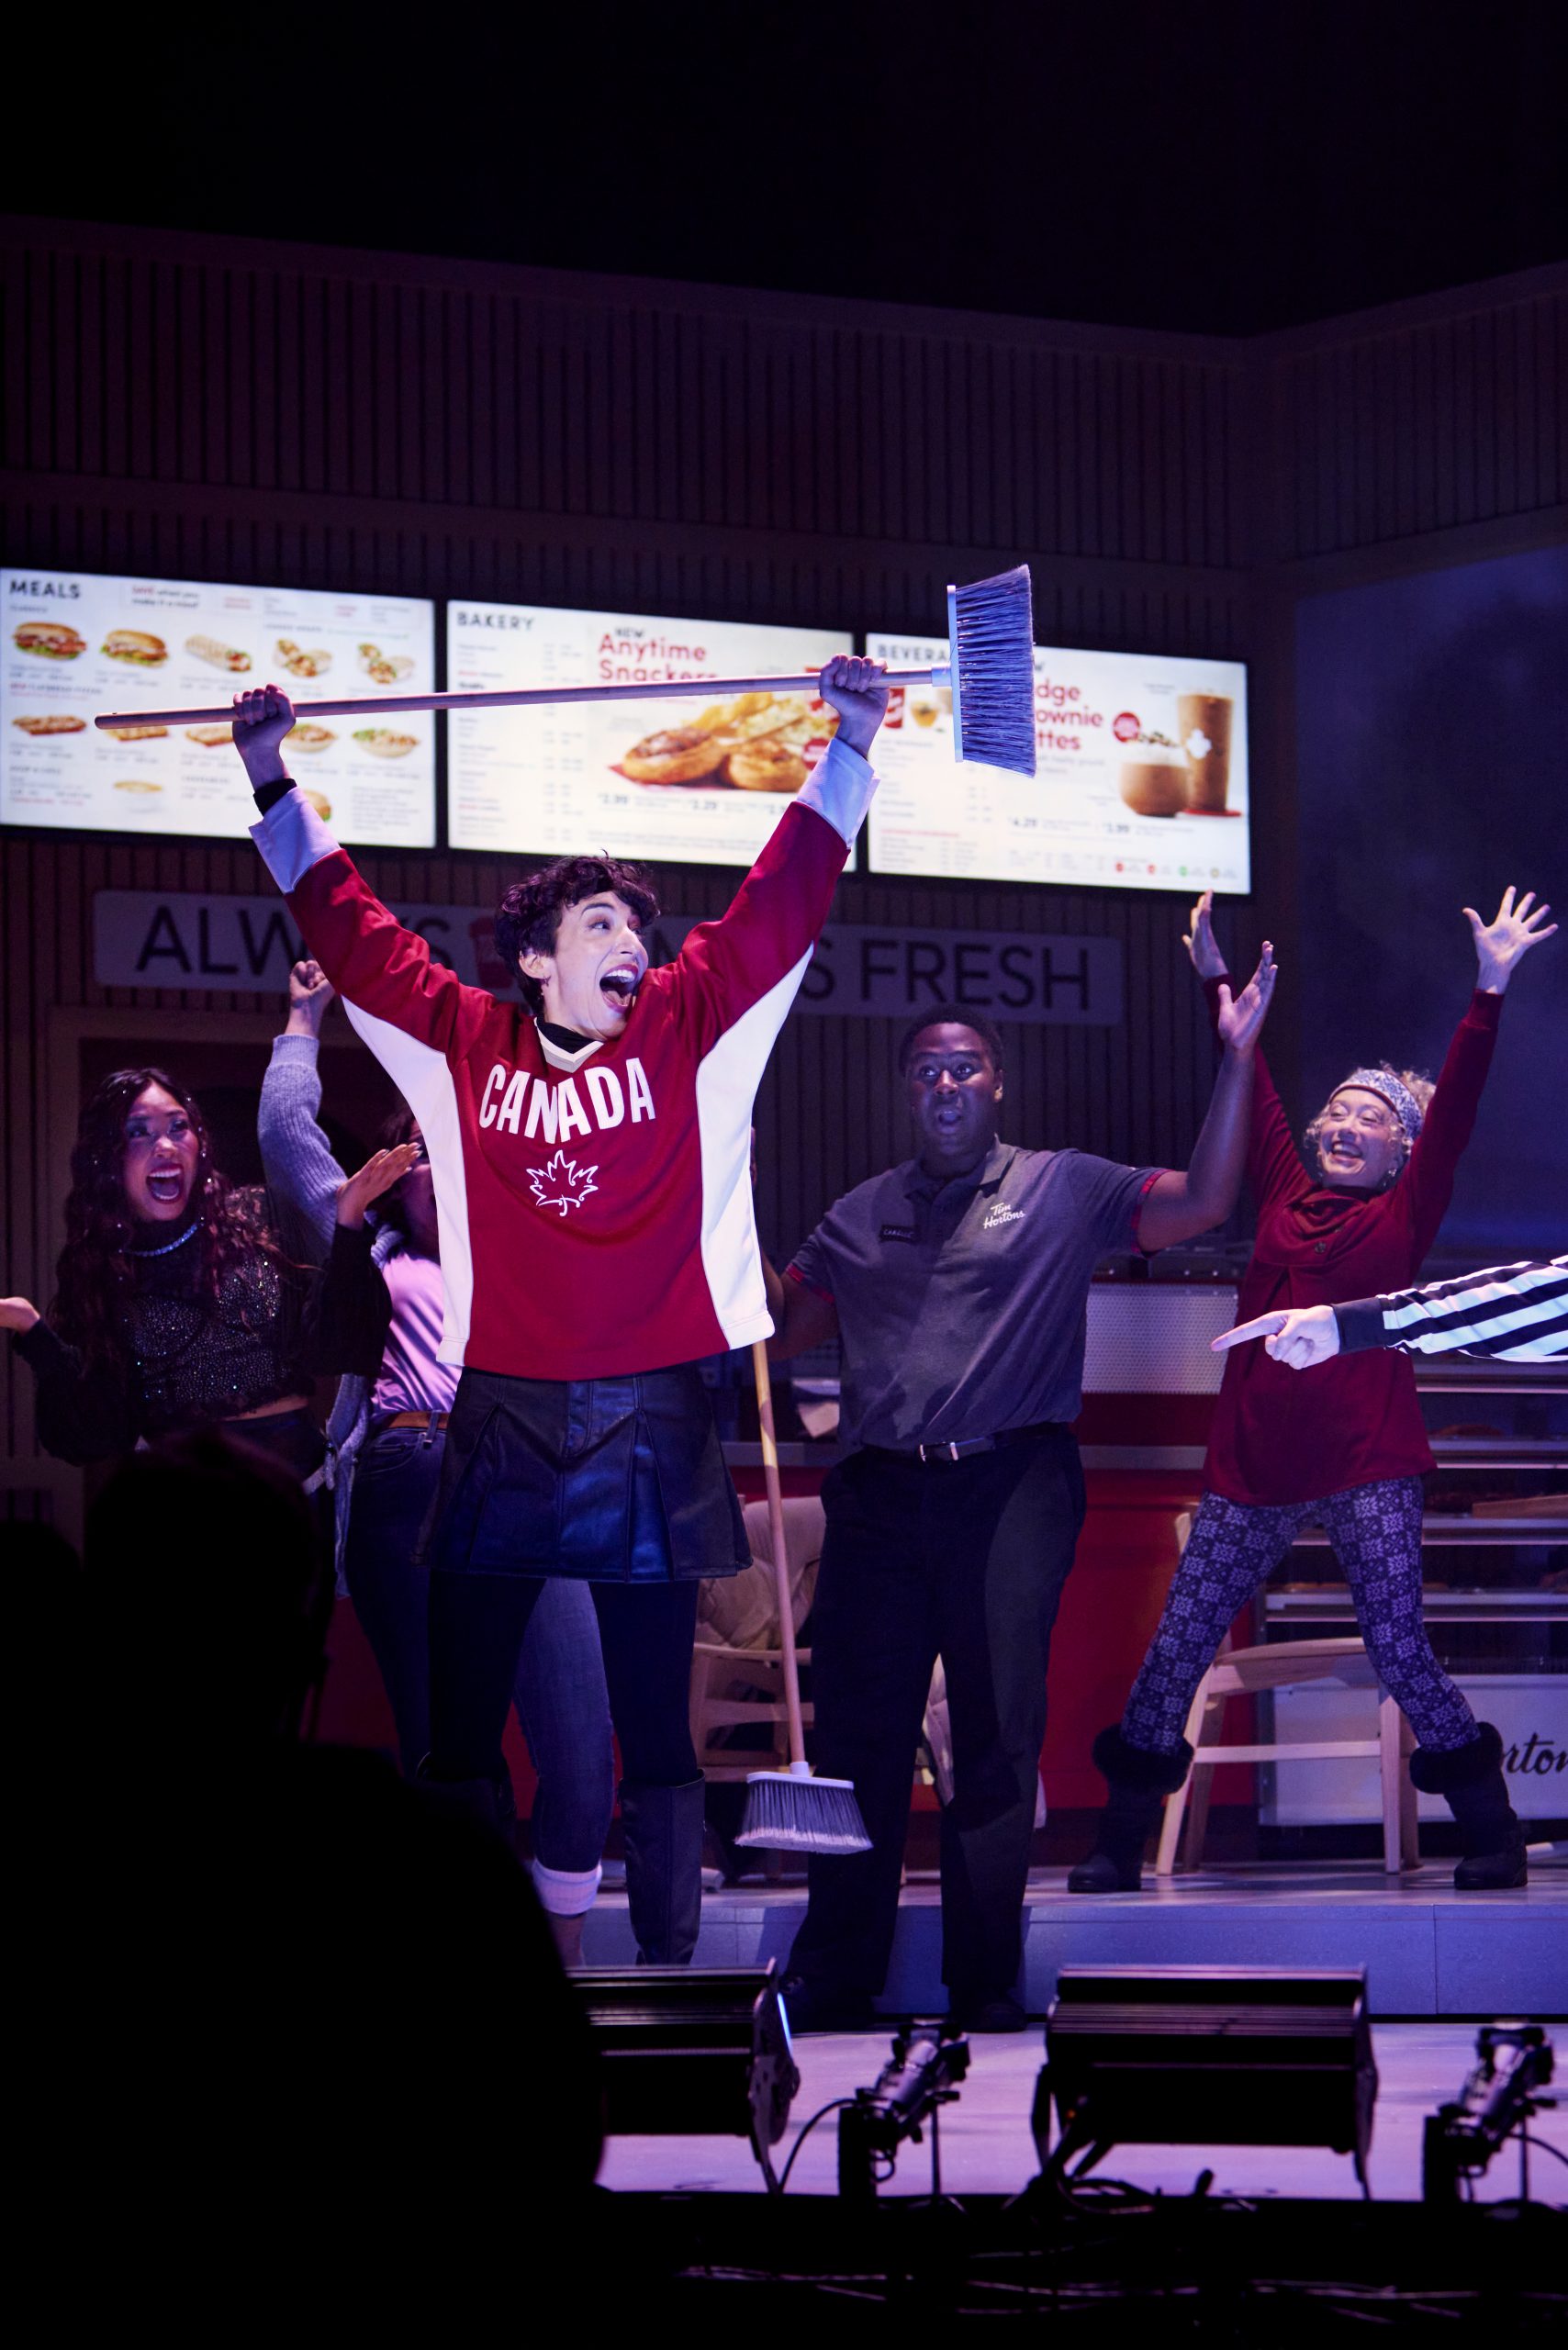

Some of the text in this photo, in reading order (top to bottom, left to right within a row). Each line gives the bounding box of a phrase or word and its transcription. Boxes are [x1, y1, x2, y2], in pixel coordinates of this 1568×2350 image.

[9, 579, 81, 599] MEALS
[457, 612, 535, 632] BAKERY
[615, 628, 644, 639] NEW
[599, 633, 707, 662] Anytime
[878, 643, 948, 662] BEVERA
[1036, 678, 1081, 706] dge
[1036, 706, 1103, 728] ownie
[1037, 731, 1081, 751] ttes
[136, 904, 453, 976] ALWS
[859, 938, 1091, 1011] FRESH
[478, 1057, 656, 1145] CANADA
[990, 1202, 1012, 1216] Tim
[982, 1210, 1026, 1229] Hortons
